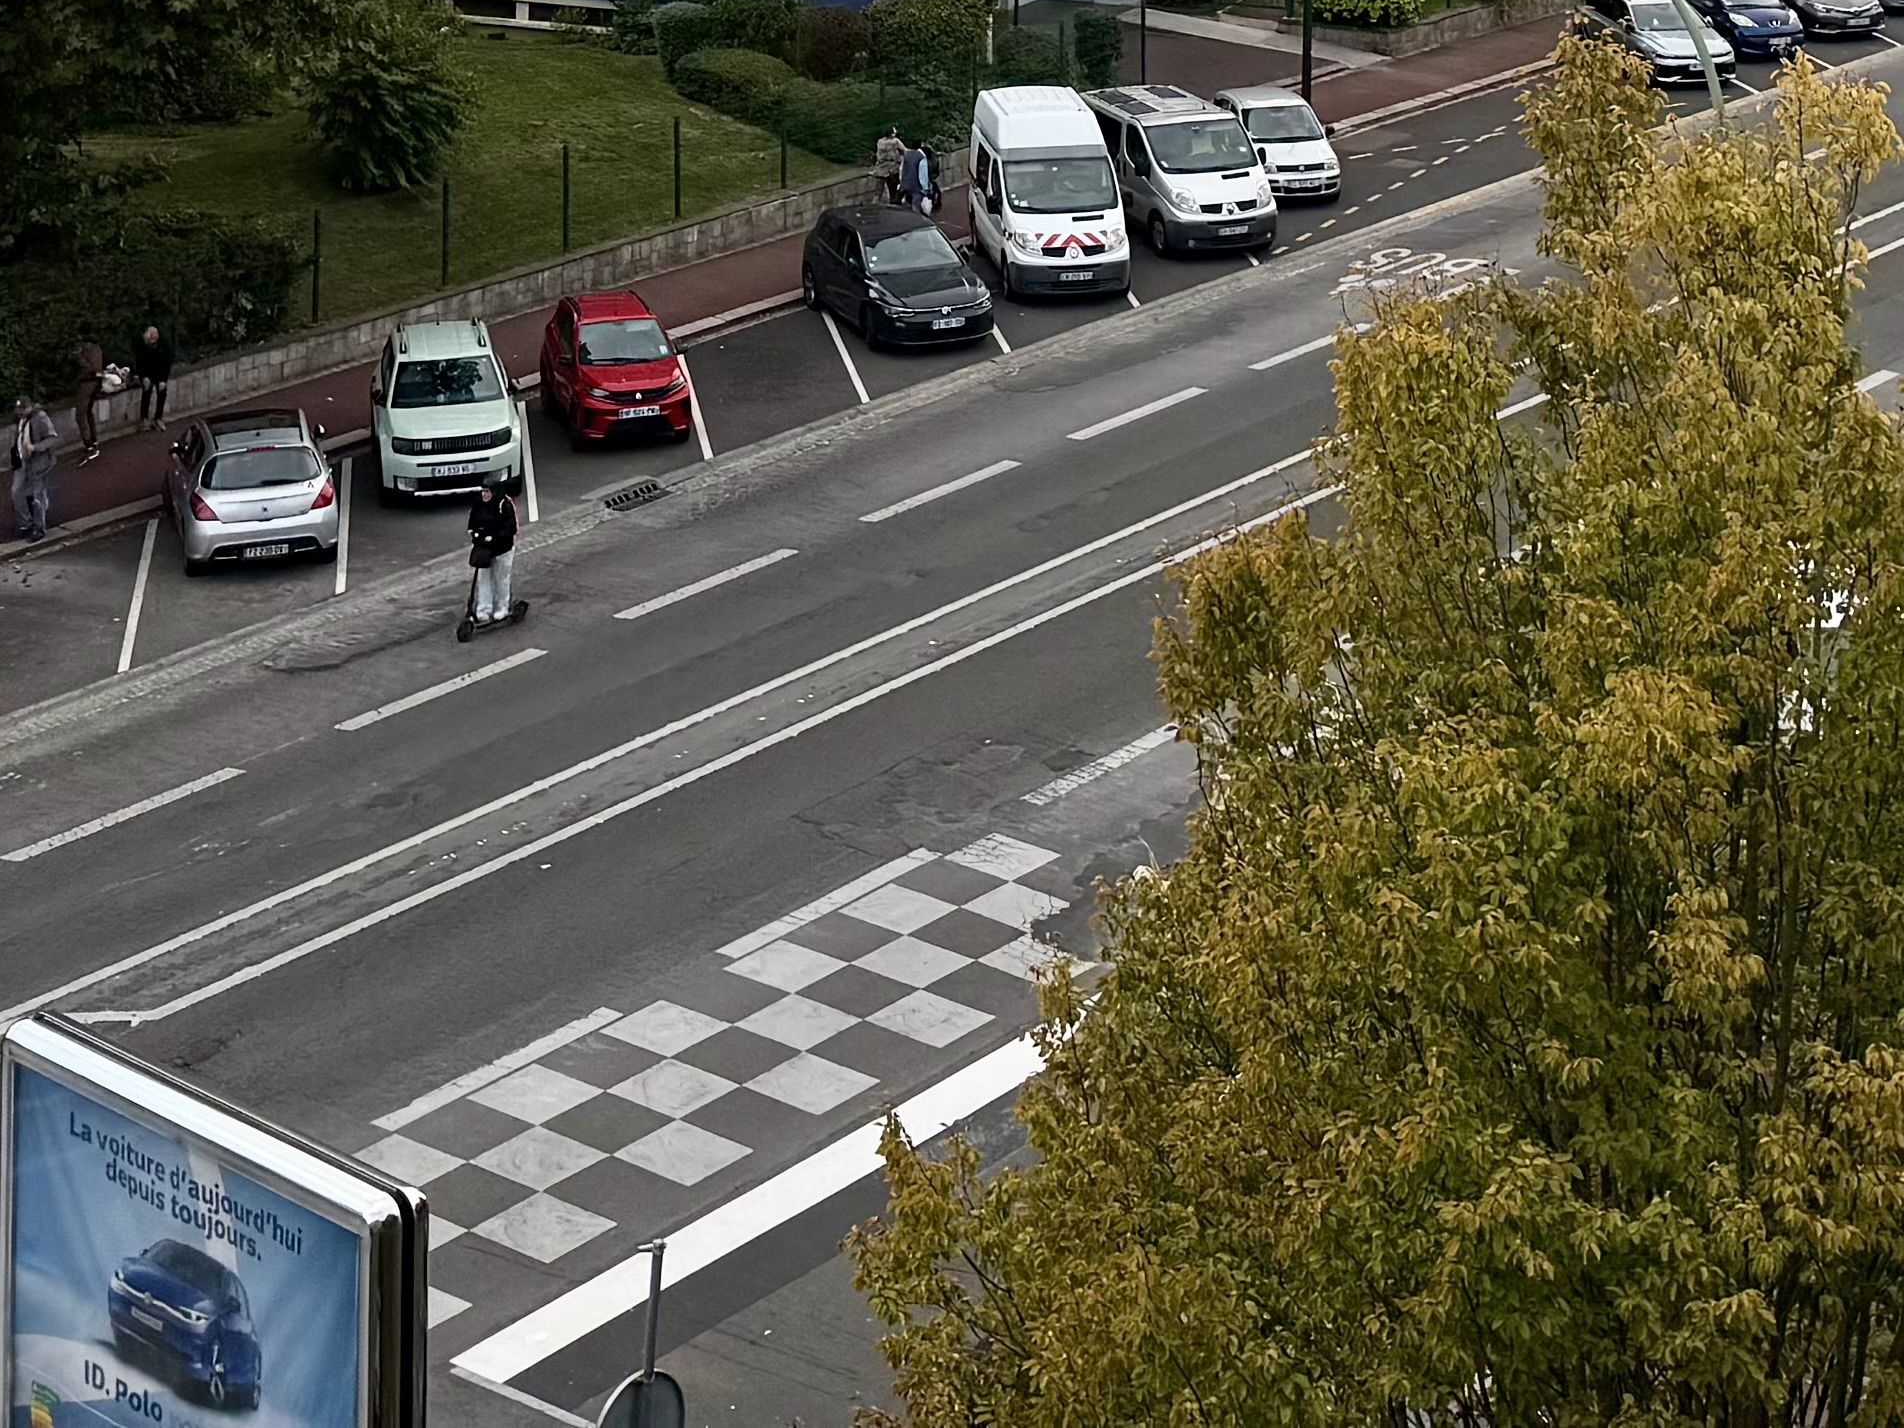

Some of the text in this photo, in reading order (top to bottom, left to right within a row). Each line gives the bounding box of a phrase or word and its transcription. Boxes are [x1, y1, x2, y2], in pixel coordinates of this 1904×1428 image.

[70, 1111, 302, 1256] La voiture d'aujourd'hui
[106, 1158, 262, 1261] depuis toujours.
[85, 1360, 110, 1396] ID.
[116, 1378, 162, 1422] Polo
